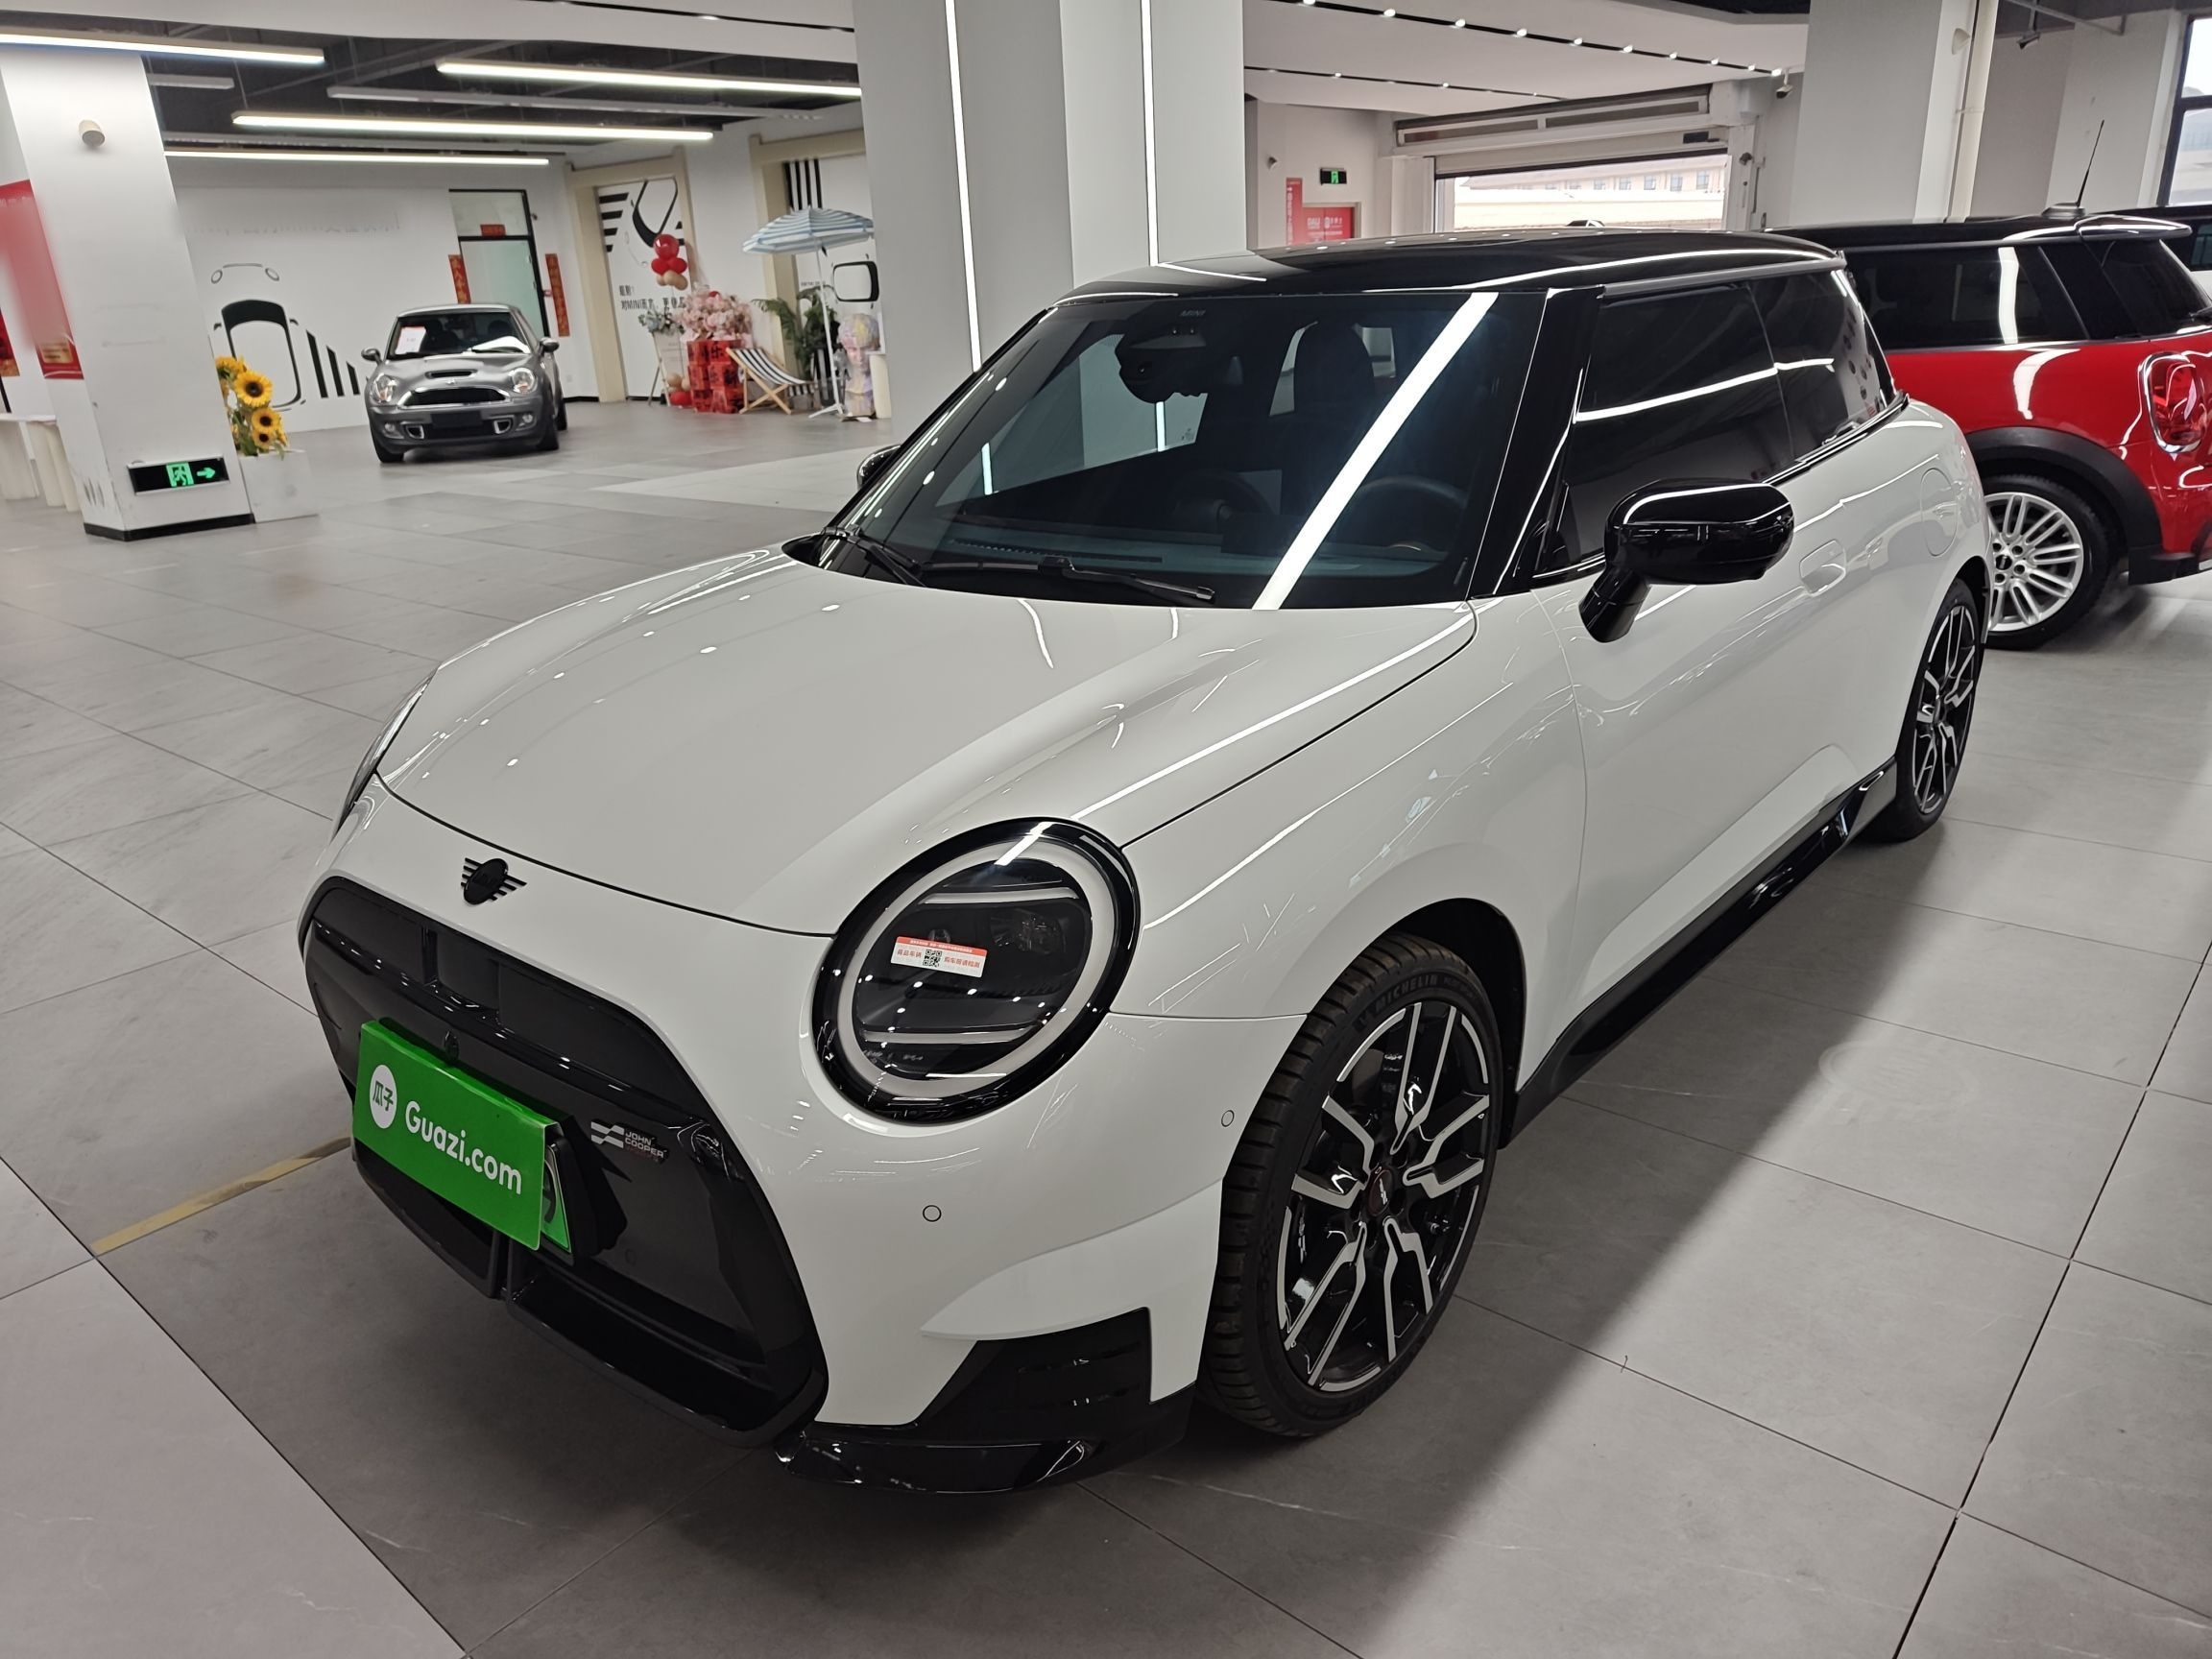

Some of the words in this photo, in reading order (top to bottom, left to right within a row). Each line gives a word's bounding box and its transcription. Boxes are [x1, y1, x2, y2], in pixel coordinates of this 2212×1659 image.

[1375, 974, 1438, 1010] MICHELIN
[373, 1089, 395, 1113] 瓜子
[405, 1101, 522, 1194] Guazi.com
[625, 1131, 653, 1145] JOHN
[625, 1138, 664, 1158] COOPER
